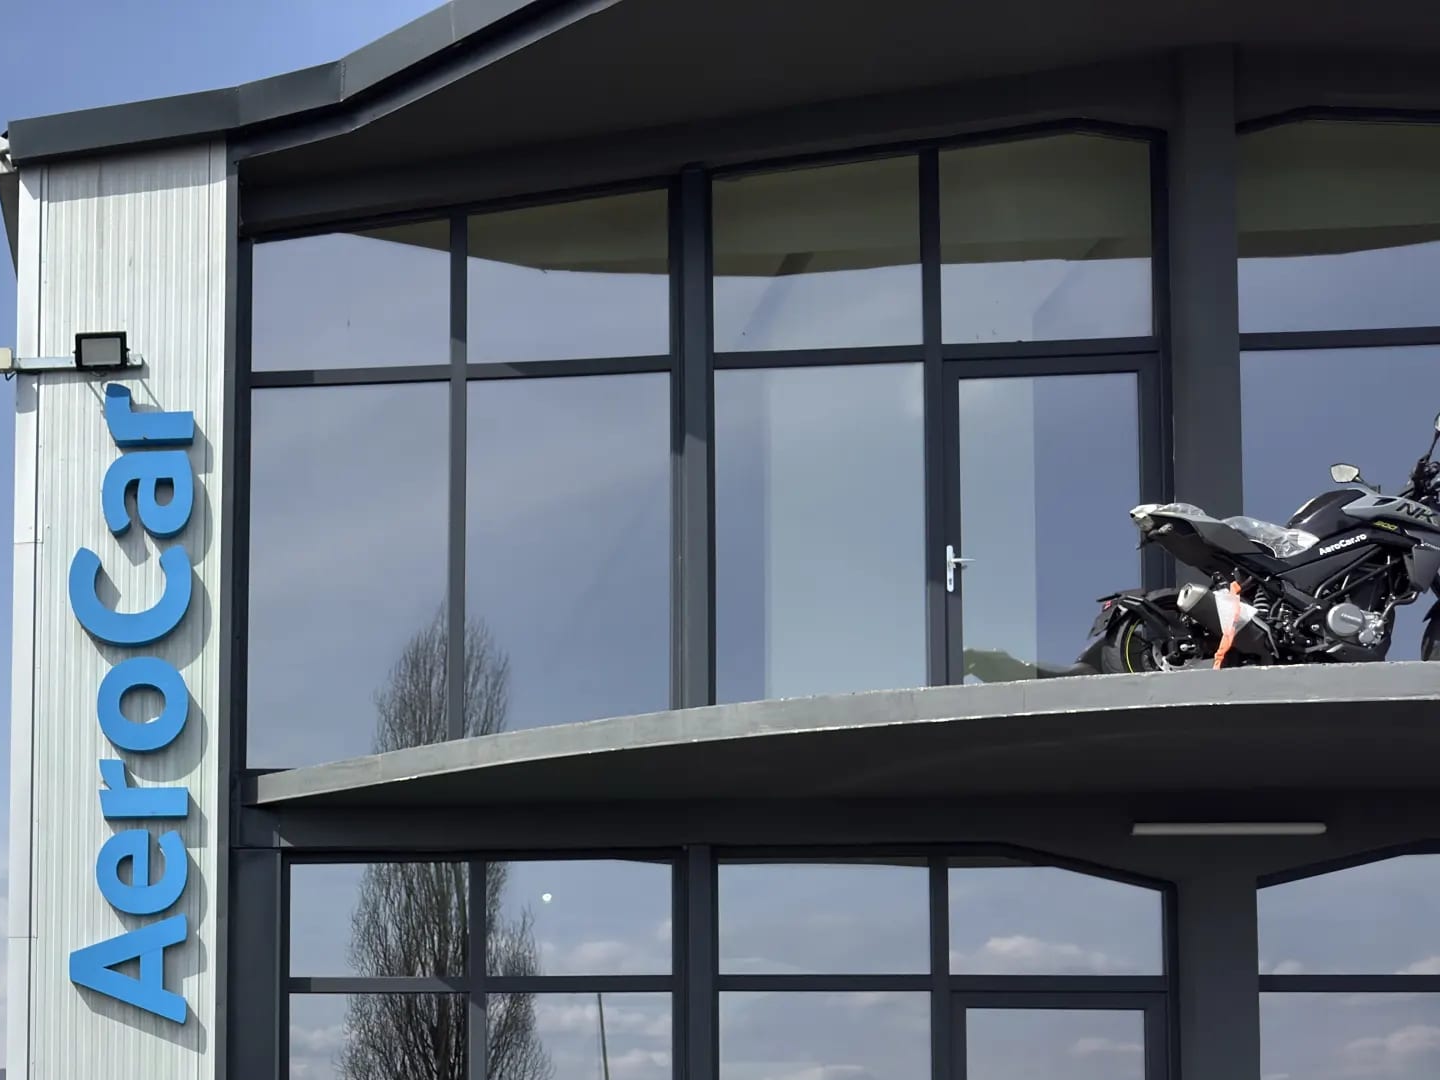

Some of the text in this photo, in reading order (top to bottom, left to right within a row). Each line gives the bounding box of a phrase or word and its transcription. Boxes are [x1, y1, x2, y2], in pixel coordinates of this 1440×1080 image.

[1396, 502, 1439, 525] NK
[1319, 533, 1367, 556] AeroCar.ro
[69, 382, 195, 1026] AeroCar
